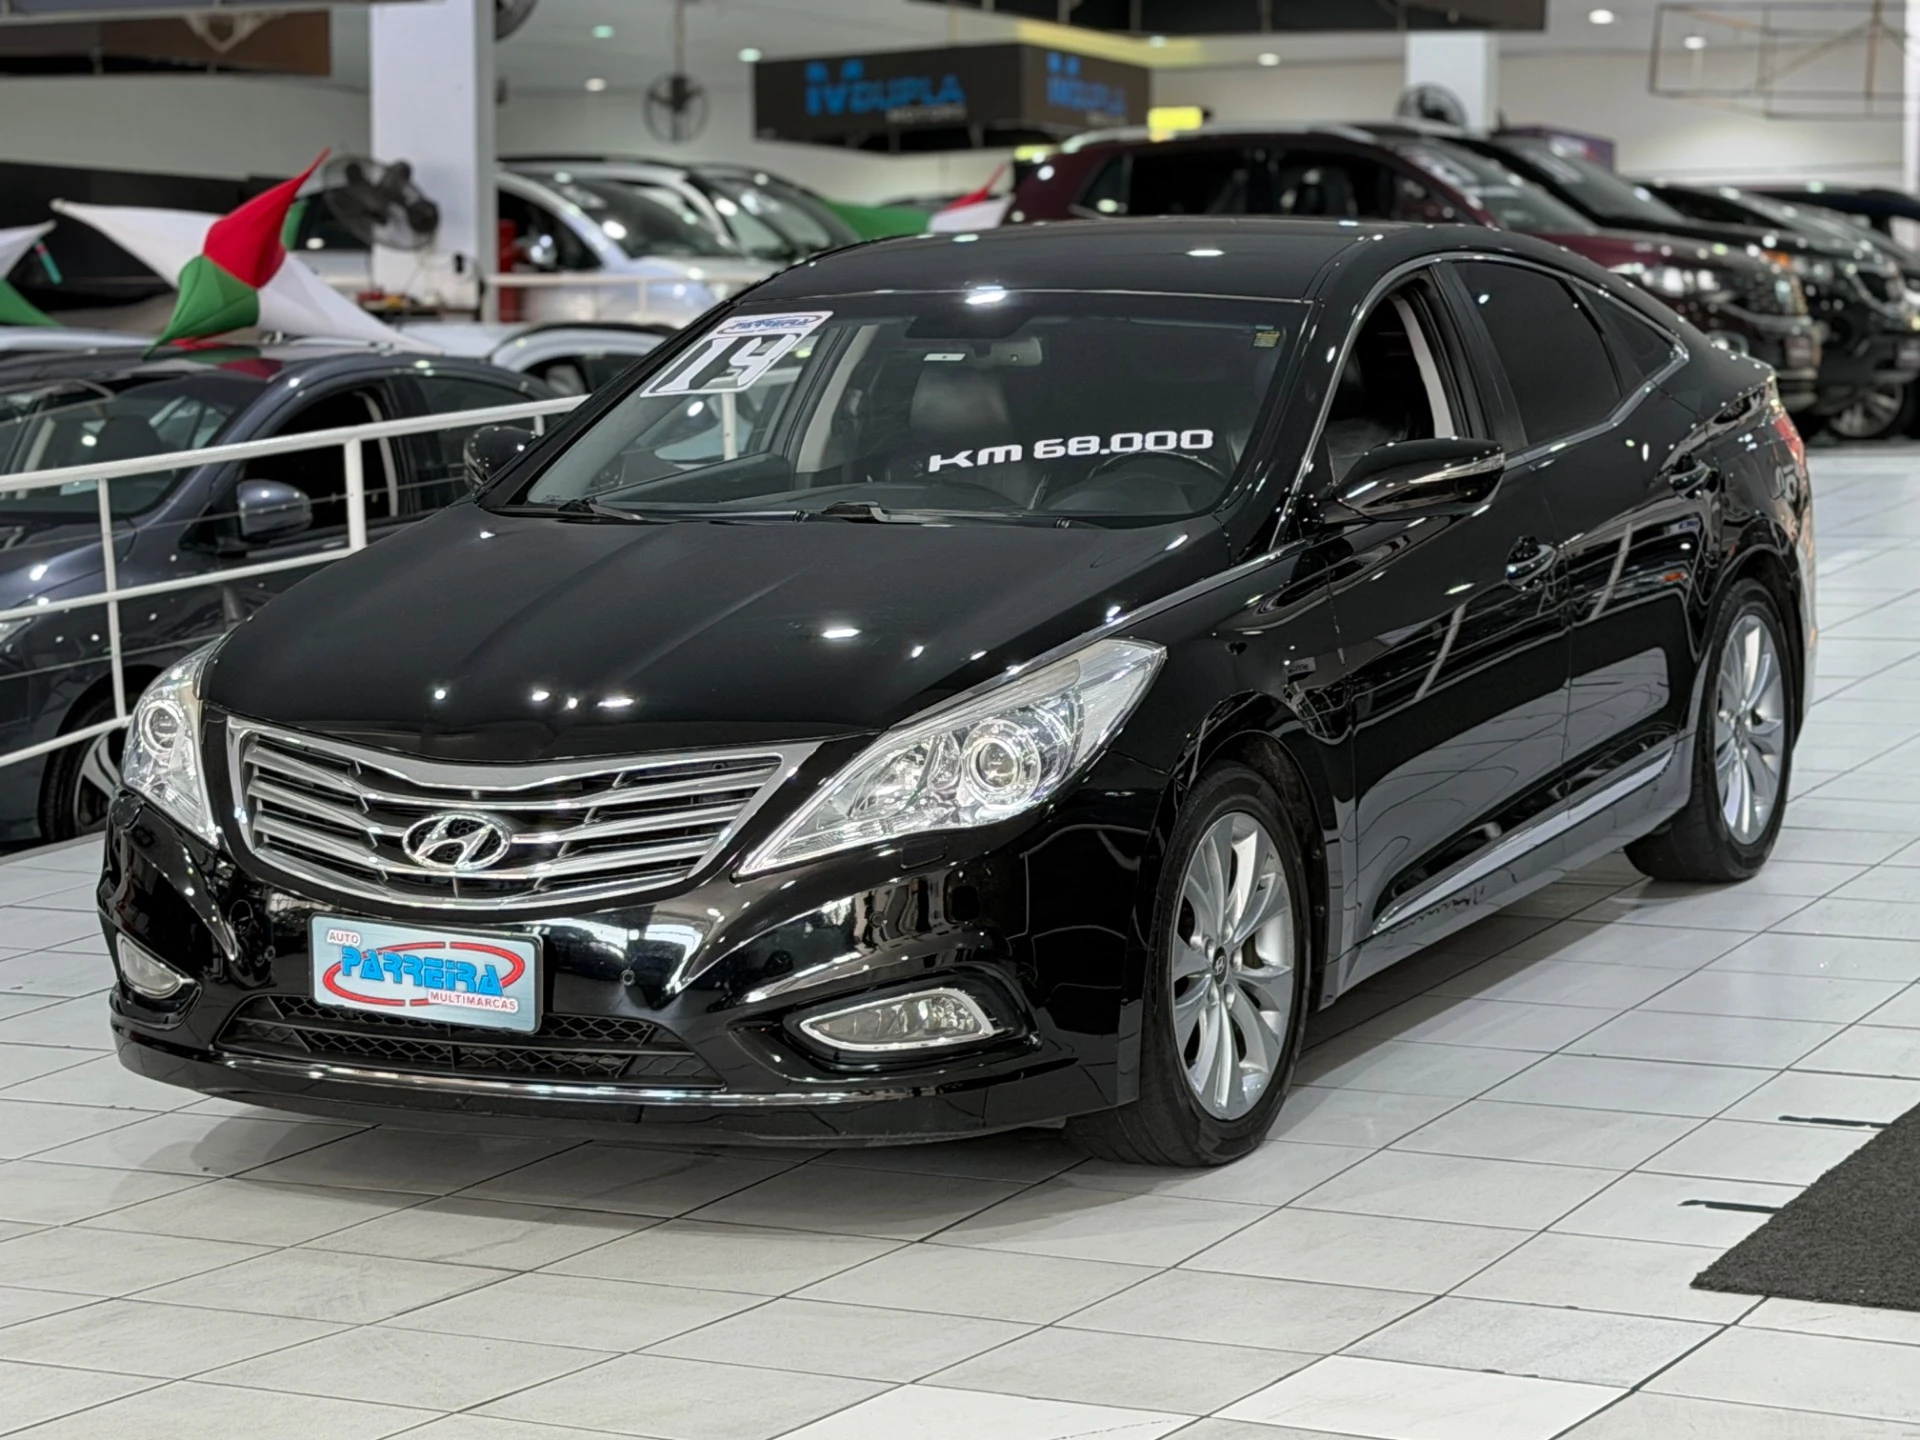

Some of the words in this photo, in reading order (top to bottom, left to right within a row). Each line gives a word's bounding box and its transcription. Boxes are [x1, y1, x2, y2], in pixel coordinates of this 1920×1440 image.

[928, 444, 1022, 472] KM
[1033, 429, 1214, 459] 68.000
[328, 931, 360, 944] AUTO
[342, 946, 503, 996] PARREIRA
[430, 991, 517, 1010] MULTIMARCAS
